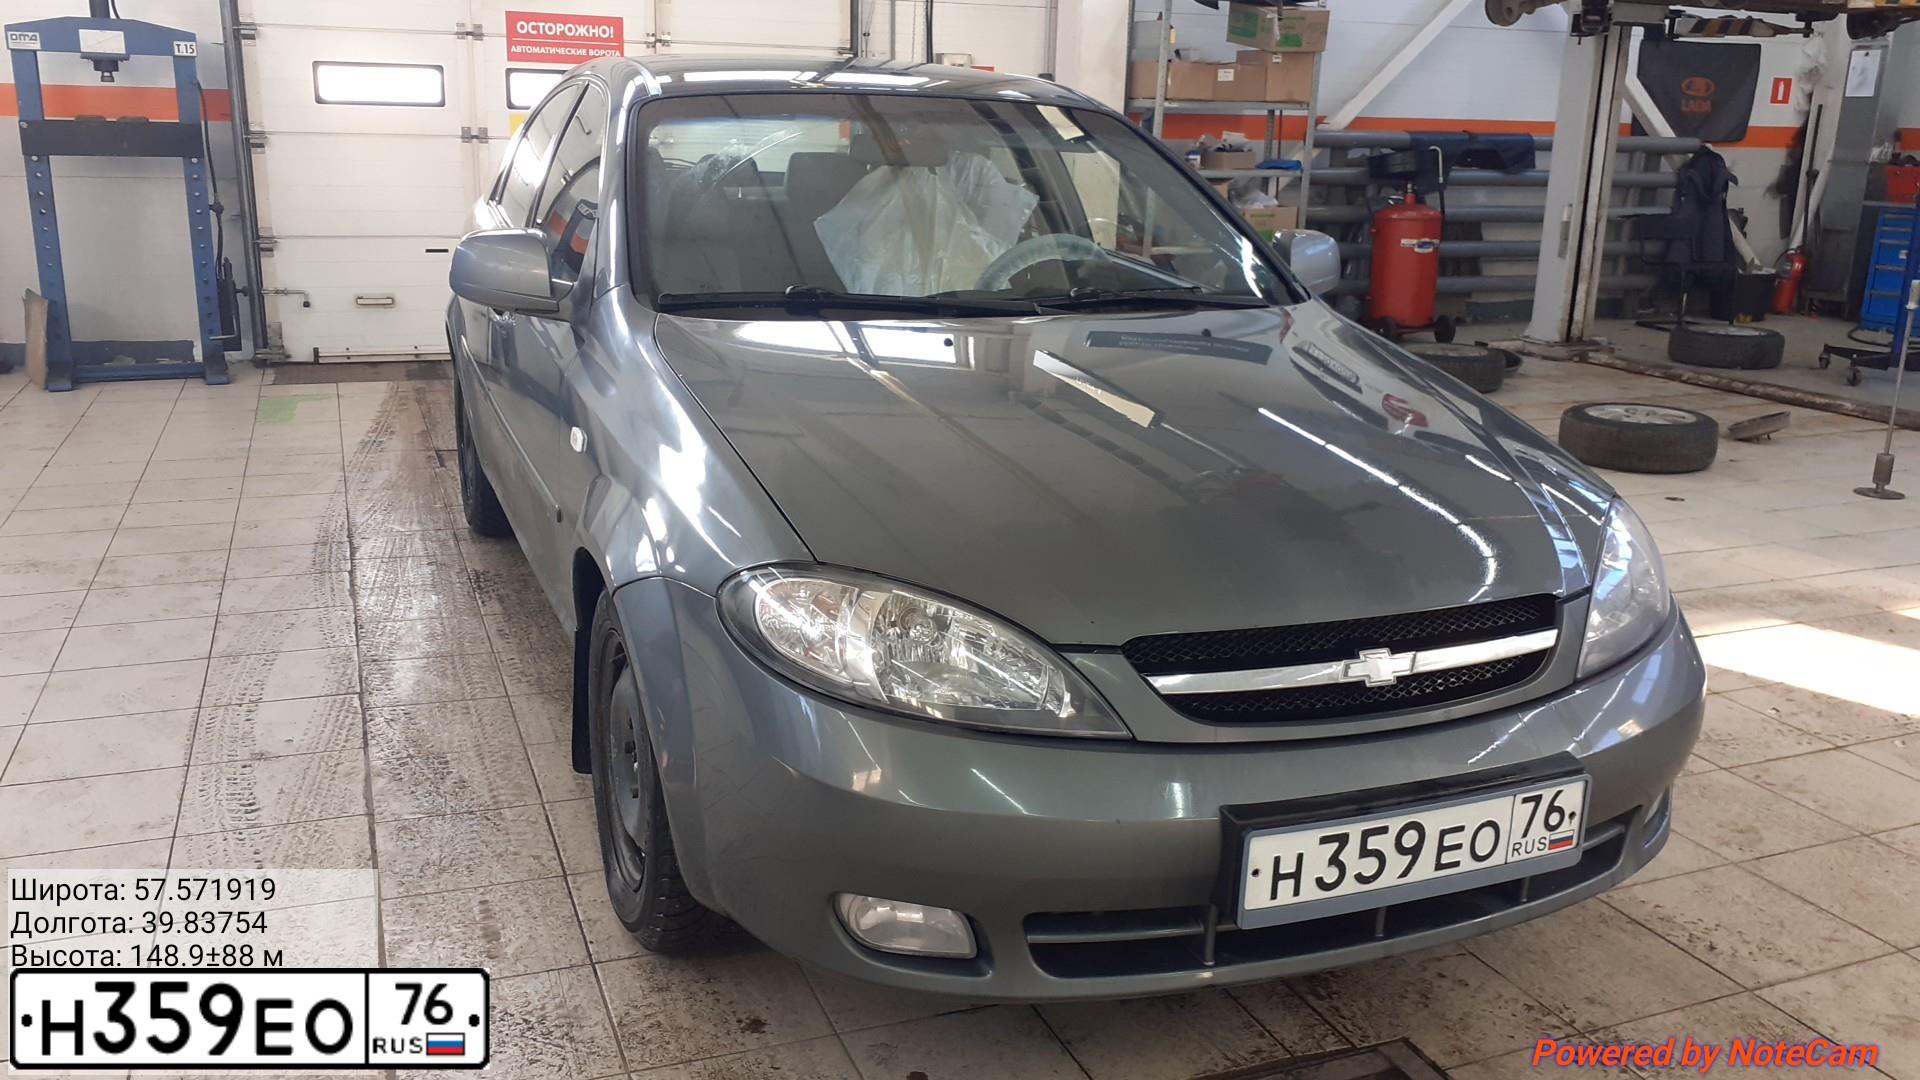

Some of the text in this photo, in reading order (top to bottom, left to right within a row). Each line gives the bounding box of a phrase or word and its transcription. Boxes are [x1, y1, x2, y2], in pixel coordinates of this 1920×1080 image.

[516, 21, 614, 38] ОСТОРОЖНО!
[511, 45, 621, 57] АВТОМАТИЧЕСКИЕ ВОРОТА
[1520, 789, 1566, 839] 76
[1511, 836, 1548, 858] RUS
